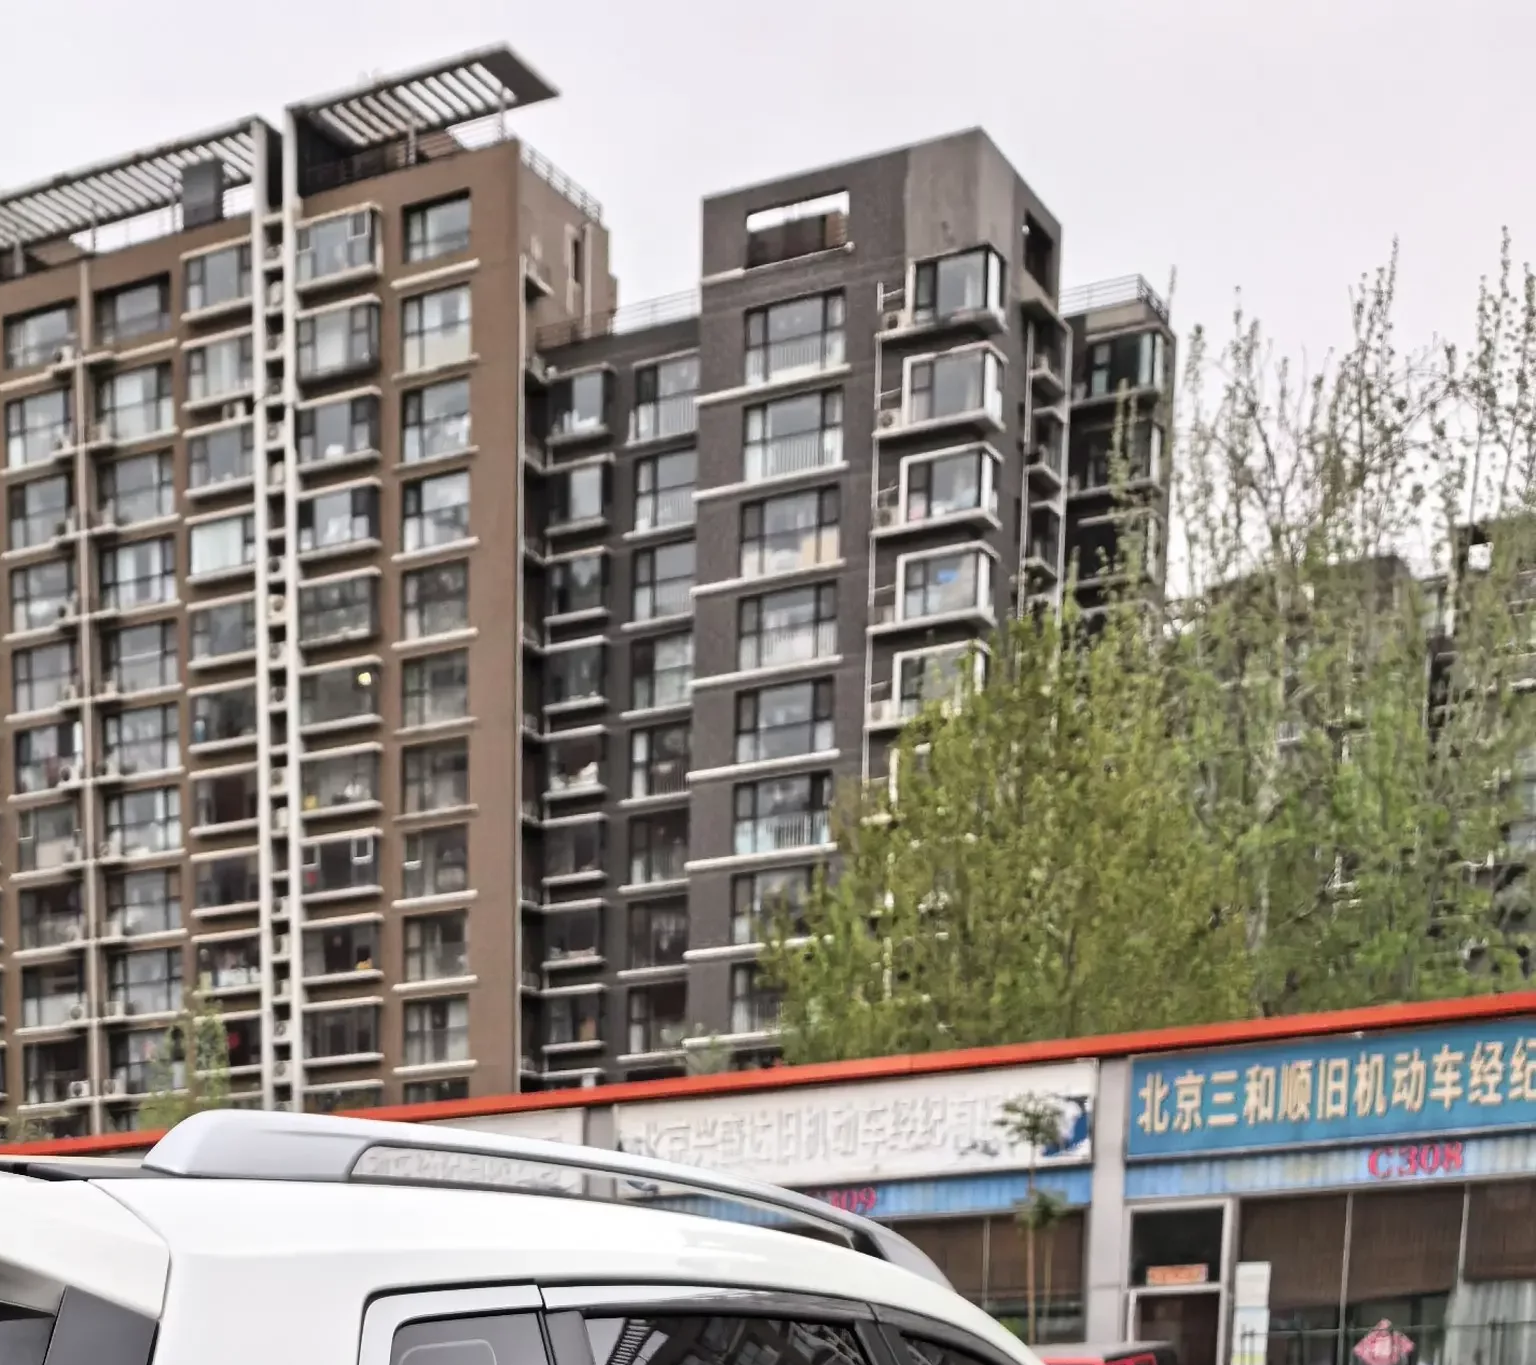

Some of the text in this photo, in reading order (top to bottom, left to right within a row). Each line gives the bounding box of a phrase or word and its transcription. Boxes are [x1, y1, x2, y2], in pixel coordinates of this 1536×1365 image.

[1137, 1037, 1536, 1135] 北京三和顺旧机动车经纪
[1367, 1141, 1463, 1178] C308
